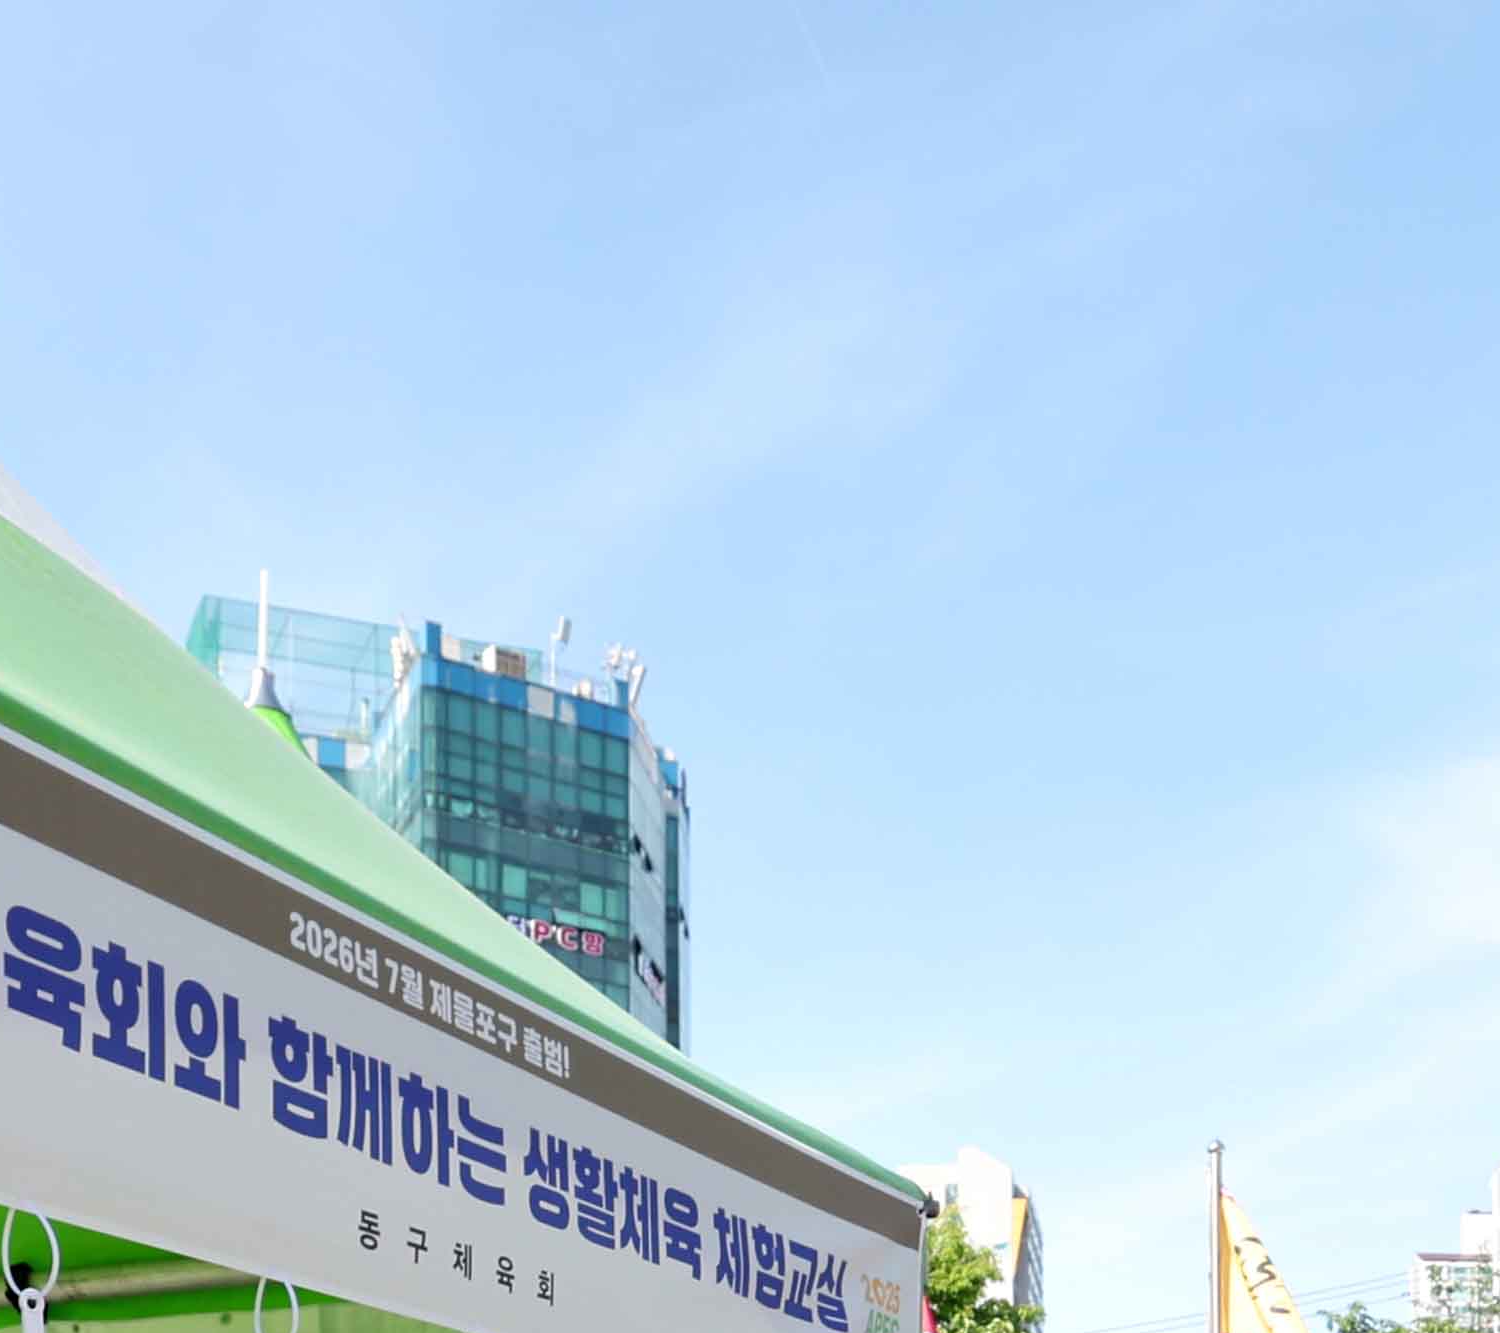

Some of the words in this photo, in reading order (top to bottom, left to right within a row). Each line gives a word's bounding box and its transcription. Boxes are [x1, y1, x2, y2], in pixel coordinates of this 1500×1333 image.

[289, 910, 379, 985] 2026년
[385, 959, 425, 1013] 7월
[429, 977, 519, 1056] 제물포구
[523, 1027, 571, 1080] 출범!
[268, 1015, 508, 1207] 함께하는
[523, 1127, 703, 1282] 생활체육
[712, 1208, 850, 1333] 체험교실
